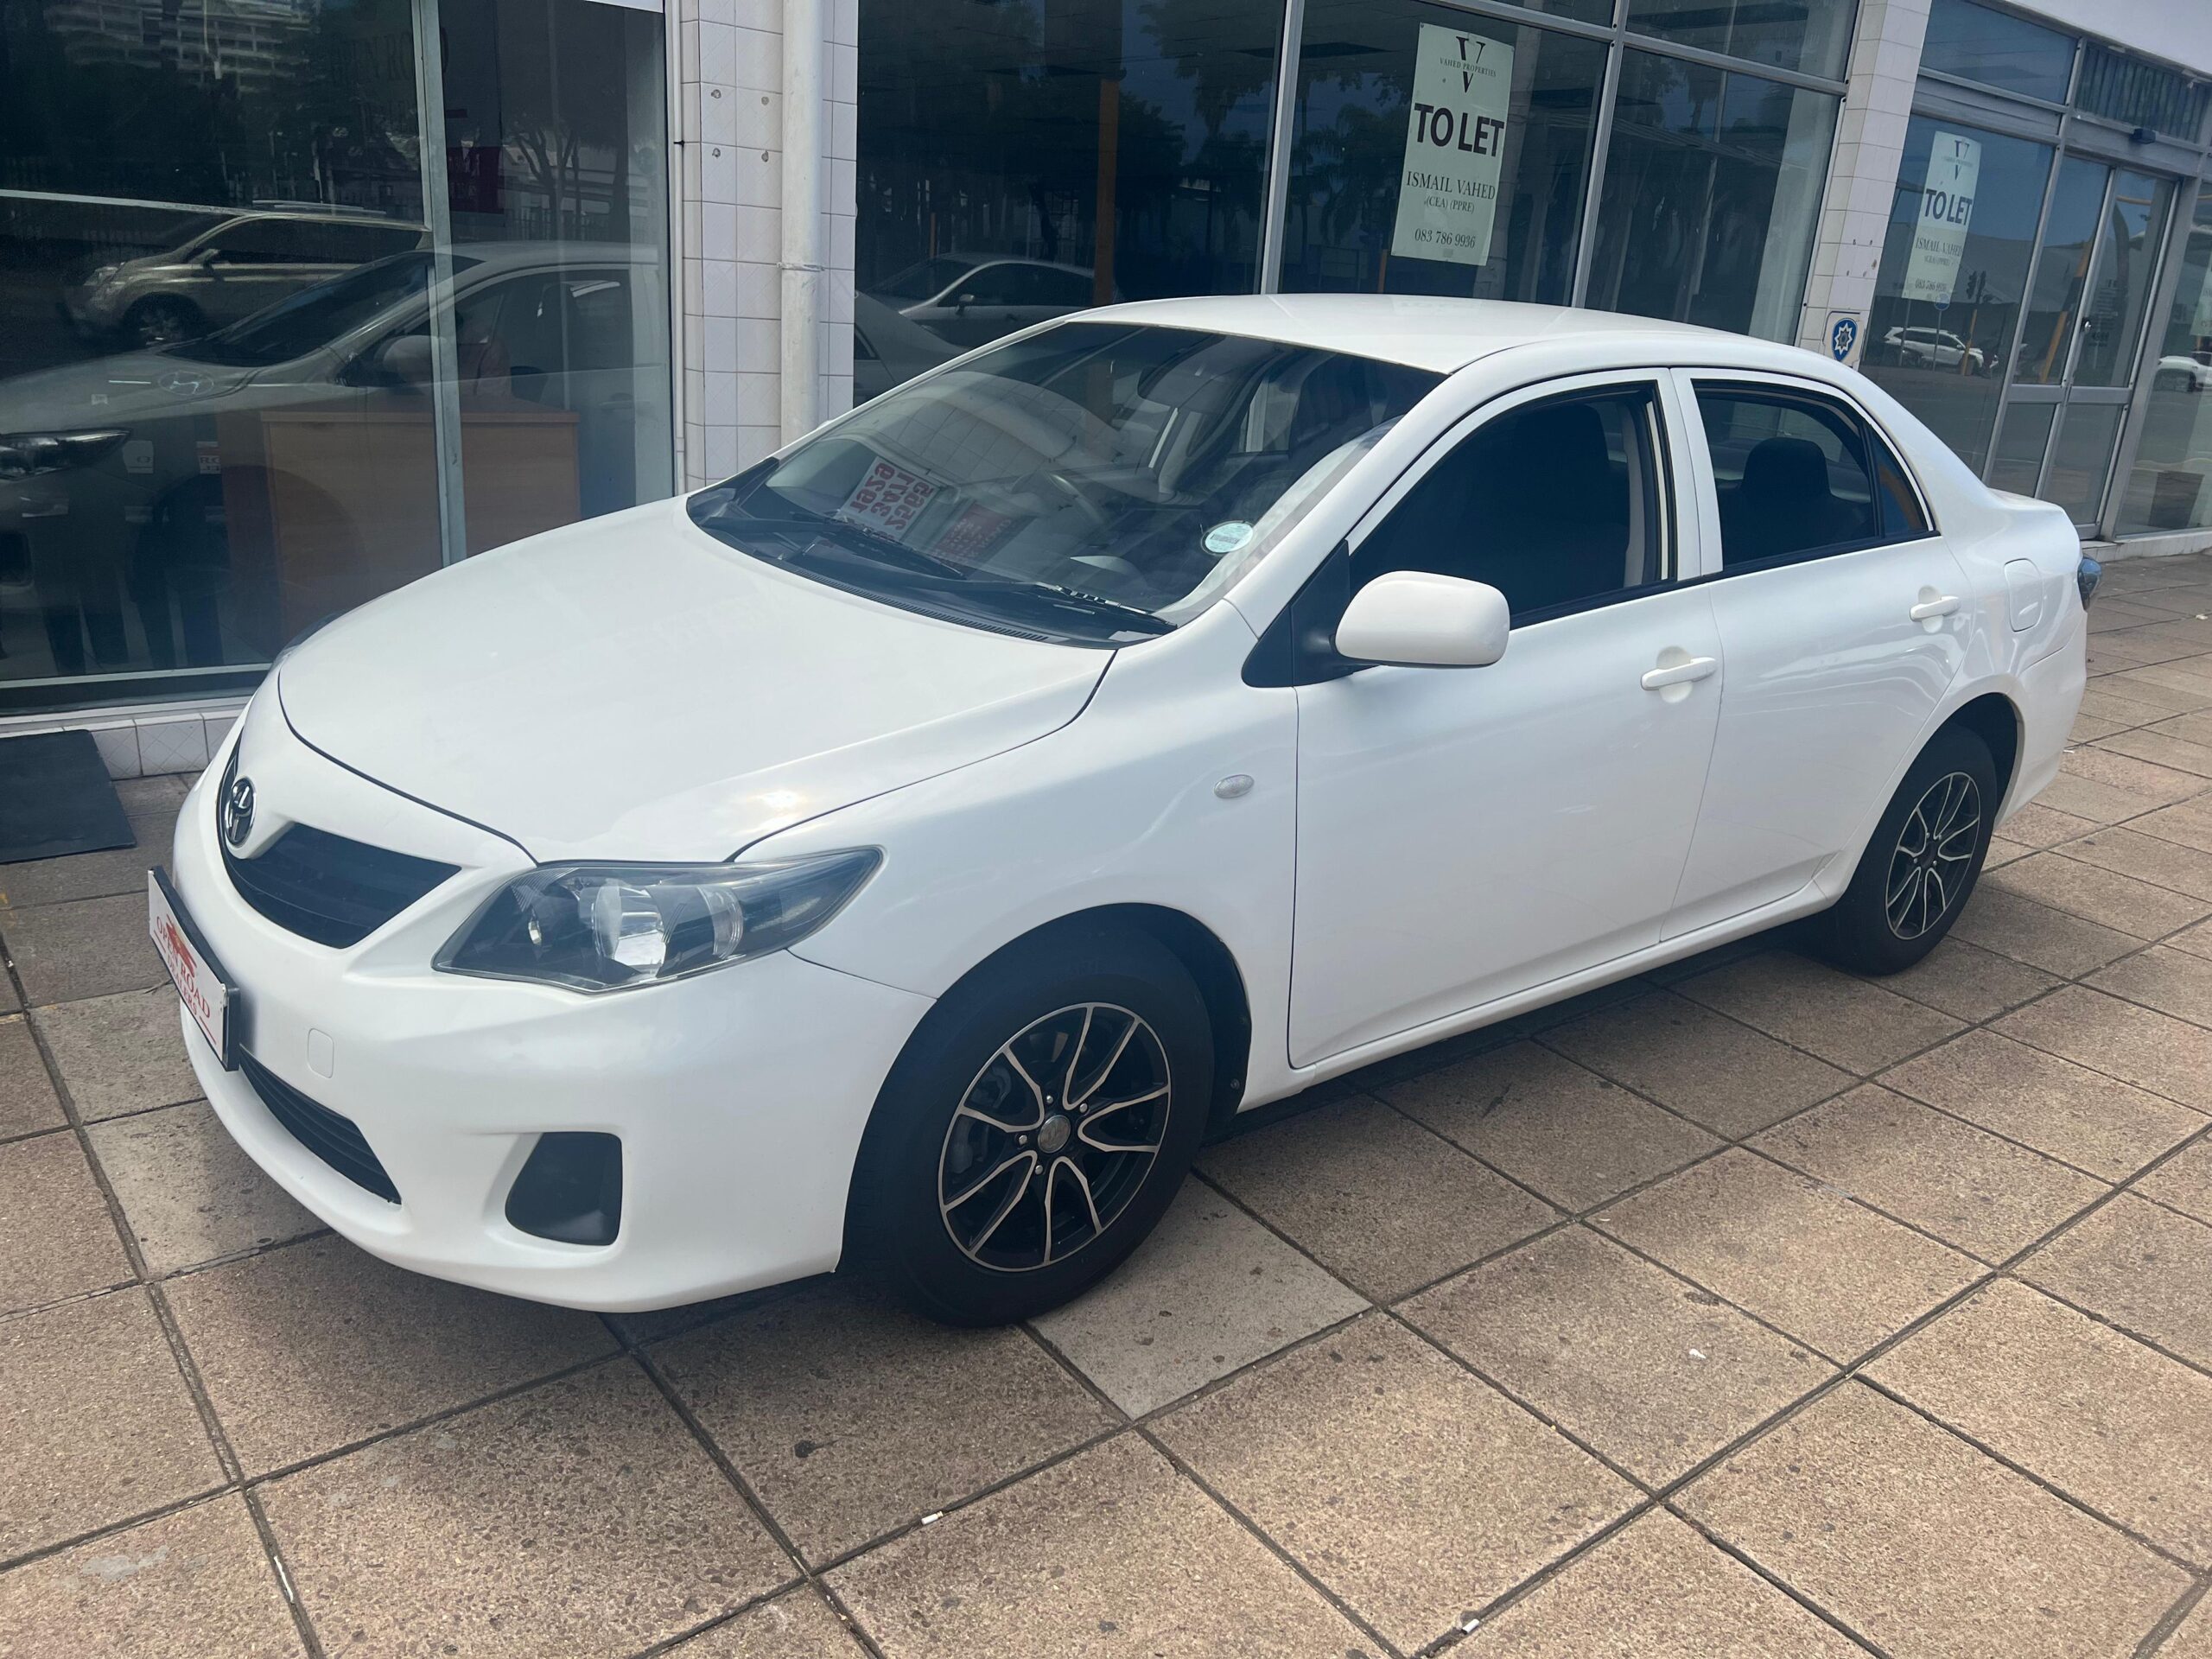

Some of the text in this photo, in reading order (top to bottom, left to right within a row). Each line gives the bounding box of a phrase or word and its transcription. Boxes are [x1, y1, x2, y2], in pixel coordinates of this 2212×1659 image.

[1440, 57, 1497, 78] VAHED PROPERTIES
[1414, 102, 1505, 157] TO LET
[1406, 171, 1496, 200] ISMAIL VAHED
[1426, 195, 1474, 214] (CEA) (PPRE)
[1924, 188, 1973, 226] TO LET
[1414, 228, 1433, 243] 083
[1435, 231, 1452, 245] 786
[167, 953, 198, 1016] DEALERS
[181, 963, 211, 1019] ROAD
